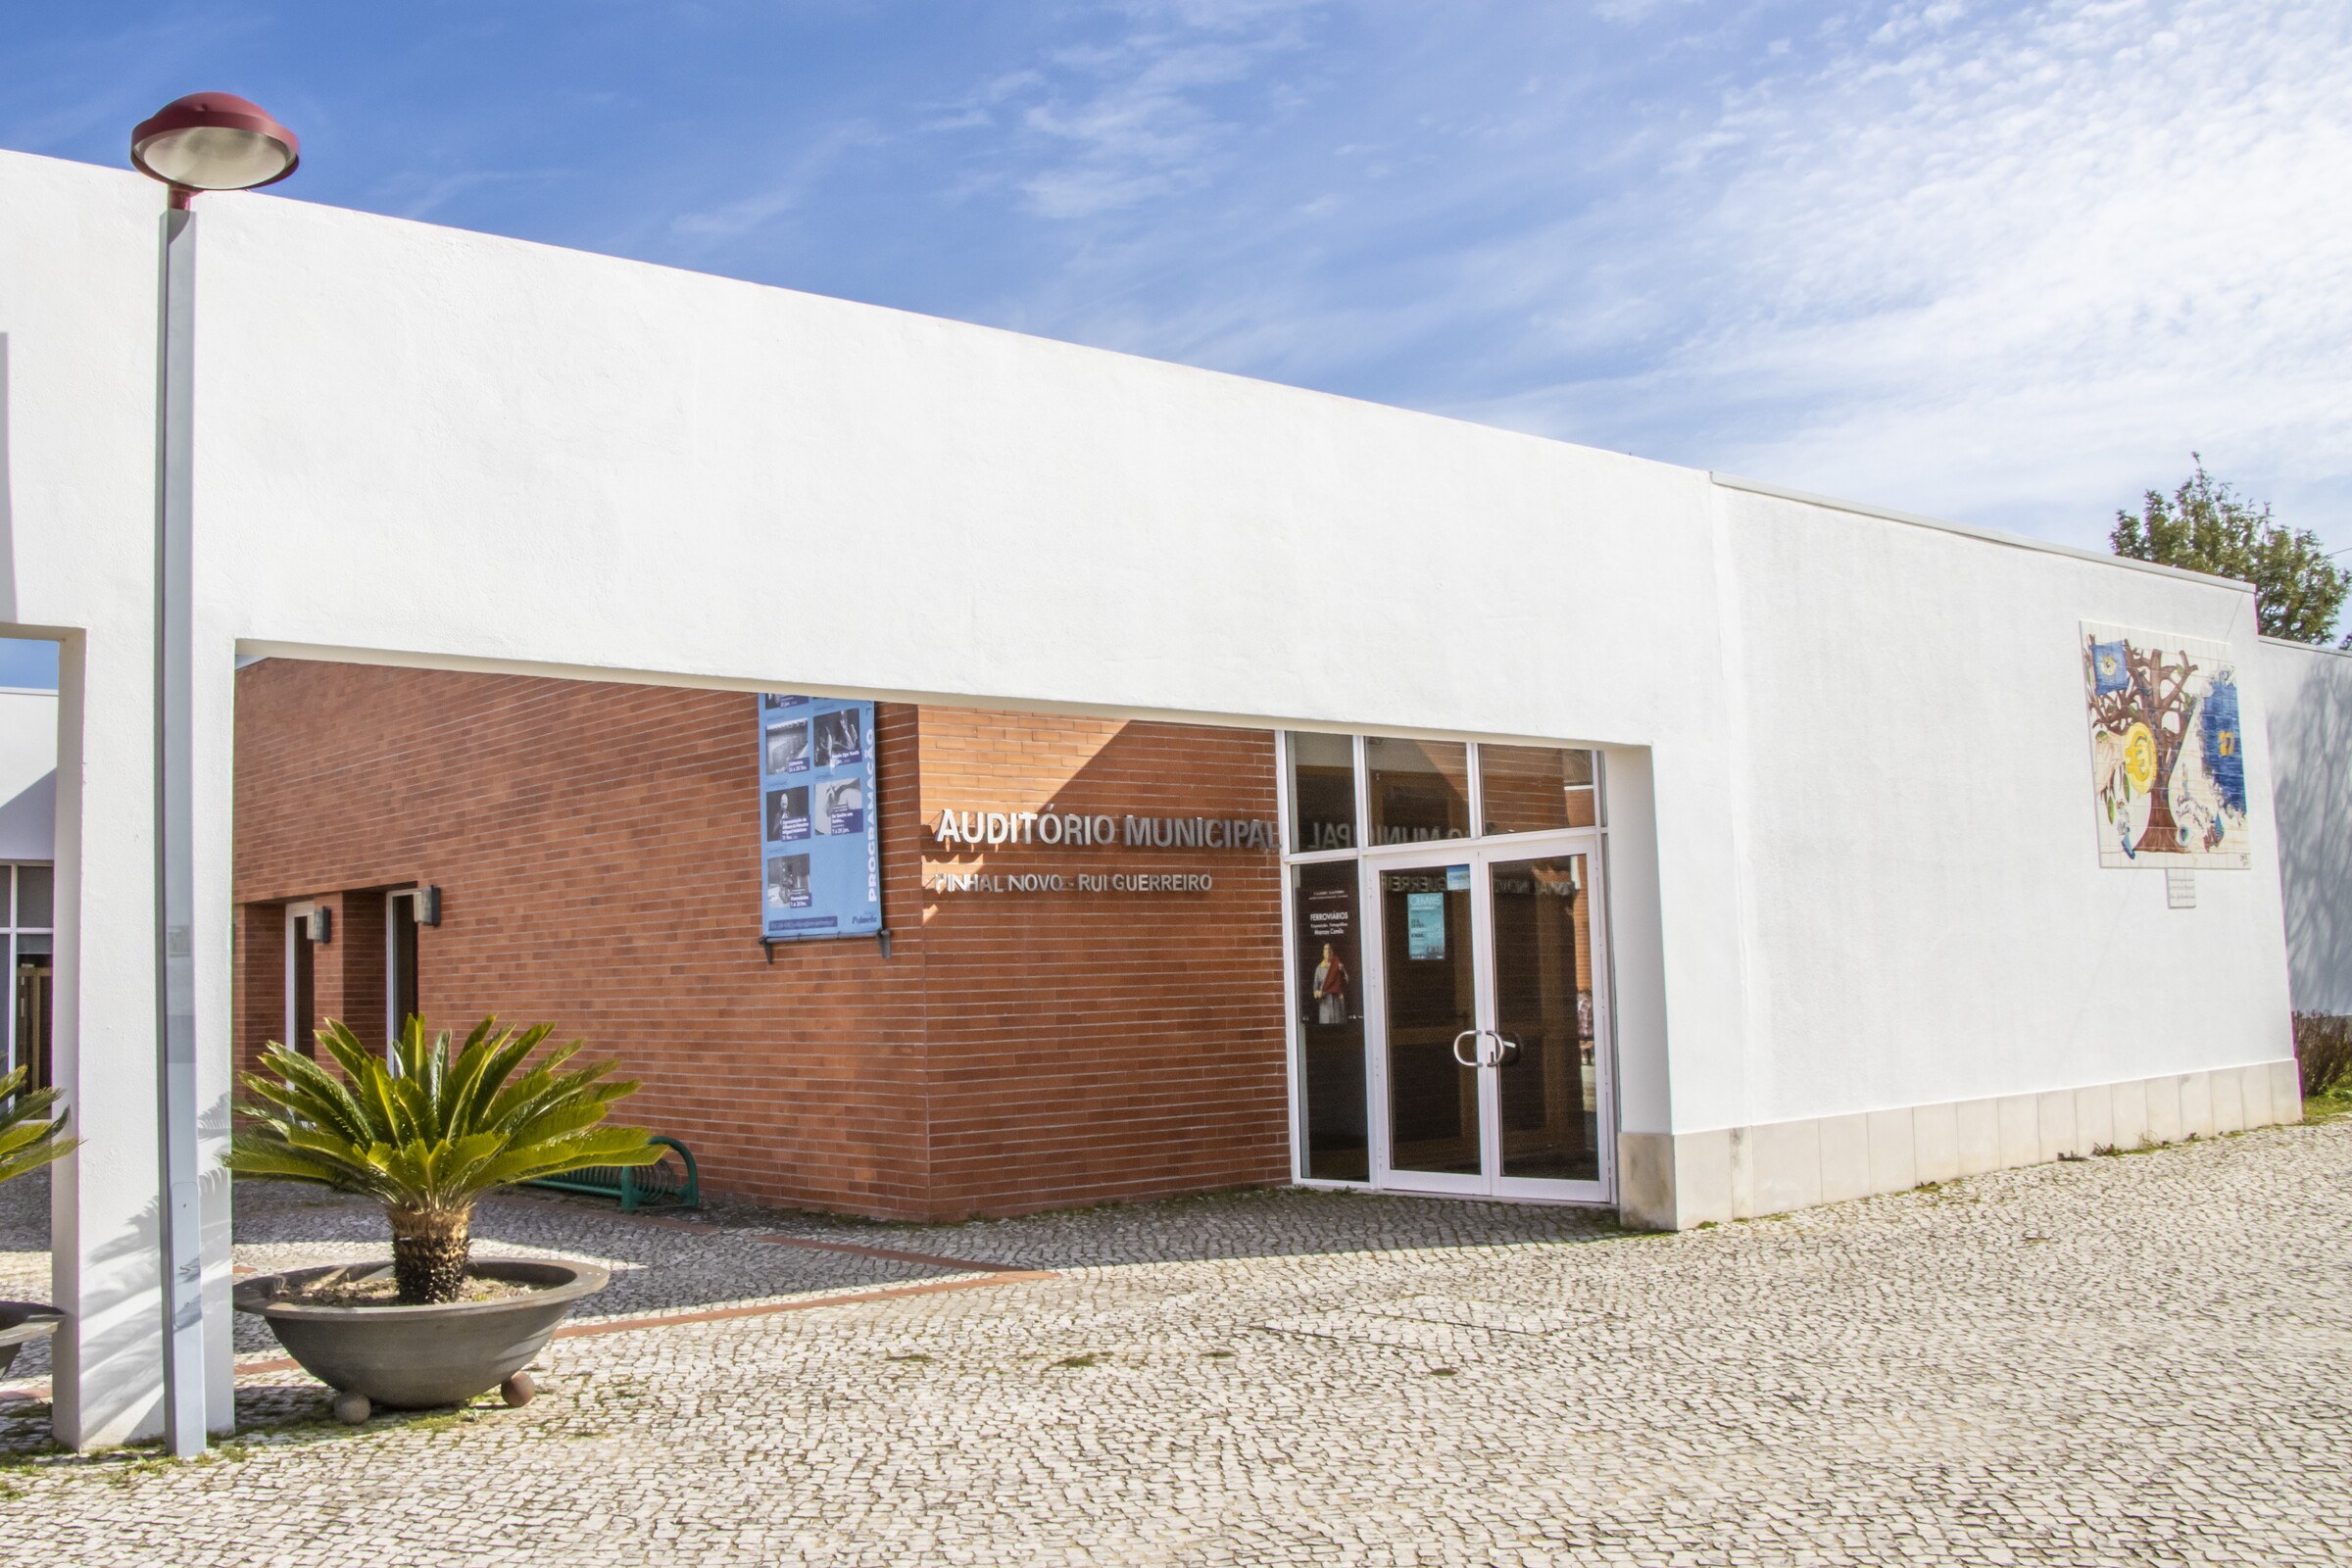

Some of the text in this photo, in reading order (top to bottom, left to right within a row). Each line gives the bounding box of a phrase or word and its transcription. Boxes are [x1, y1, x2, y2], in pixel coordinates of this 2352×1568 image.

[864, 728, 877, 903] PROGRAMAÇÃO
[936, 804, 1282, 849] AUDITÓRIO MUNICIPAL
[935, 873, 1004, 893] PINHAL
[1007, 873, 1064, 892] NOVO
[1078, 873, 1107, 892] RUI
[1112, 873, 1212, 892] GUERREIRO
[1309, 910, 1348, 921] FERROVIÁRIOS
